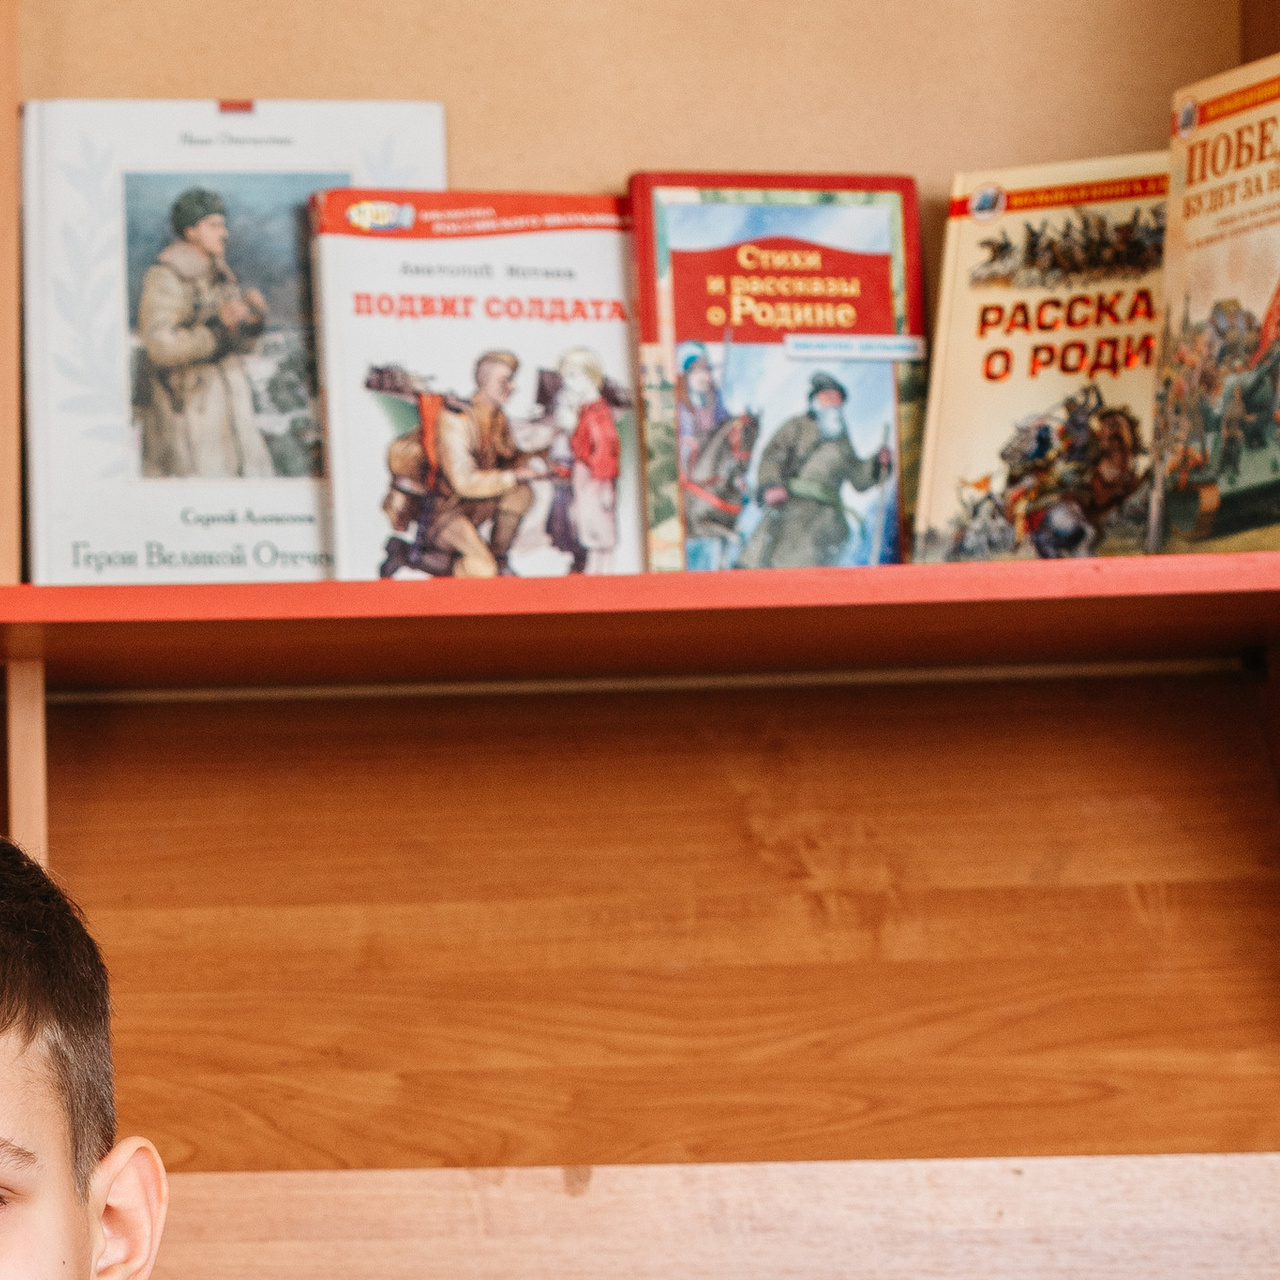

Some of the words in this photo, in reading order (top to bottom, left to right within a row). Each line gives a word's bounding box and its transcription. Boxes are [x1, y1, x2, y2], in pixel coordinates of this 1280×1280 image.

[1186, 115, 1280, 187] ПОБЕ
[736, 244, 821, 271] Стихи
[706, 275, 726, 296] и
[730, 275, 861, 298] рассказы
[353, 291, 476, 320] ПОДВИГ
[484, 296, 627, 322] СОЛДАТА
[706, 305, 727, 327] о
[730, 294, 857, 330] Родине
[978, 289, 1156, 338] РАССКА
[983, 348, 1012, 382] О
[1028, 333, 1156, 379] РОДИ
[71, 540, 139, 573] Герои
[145, 539, 248, 568] Великой
